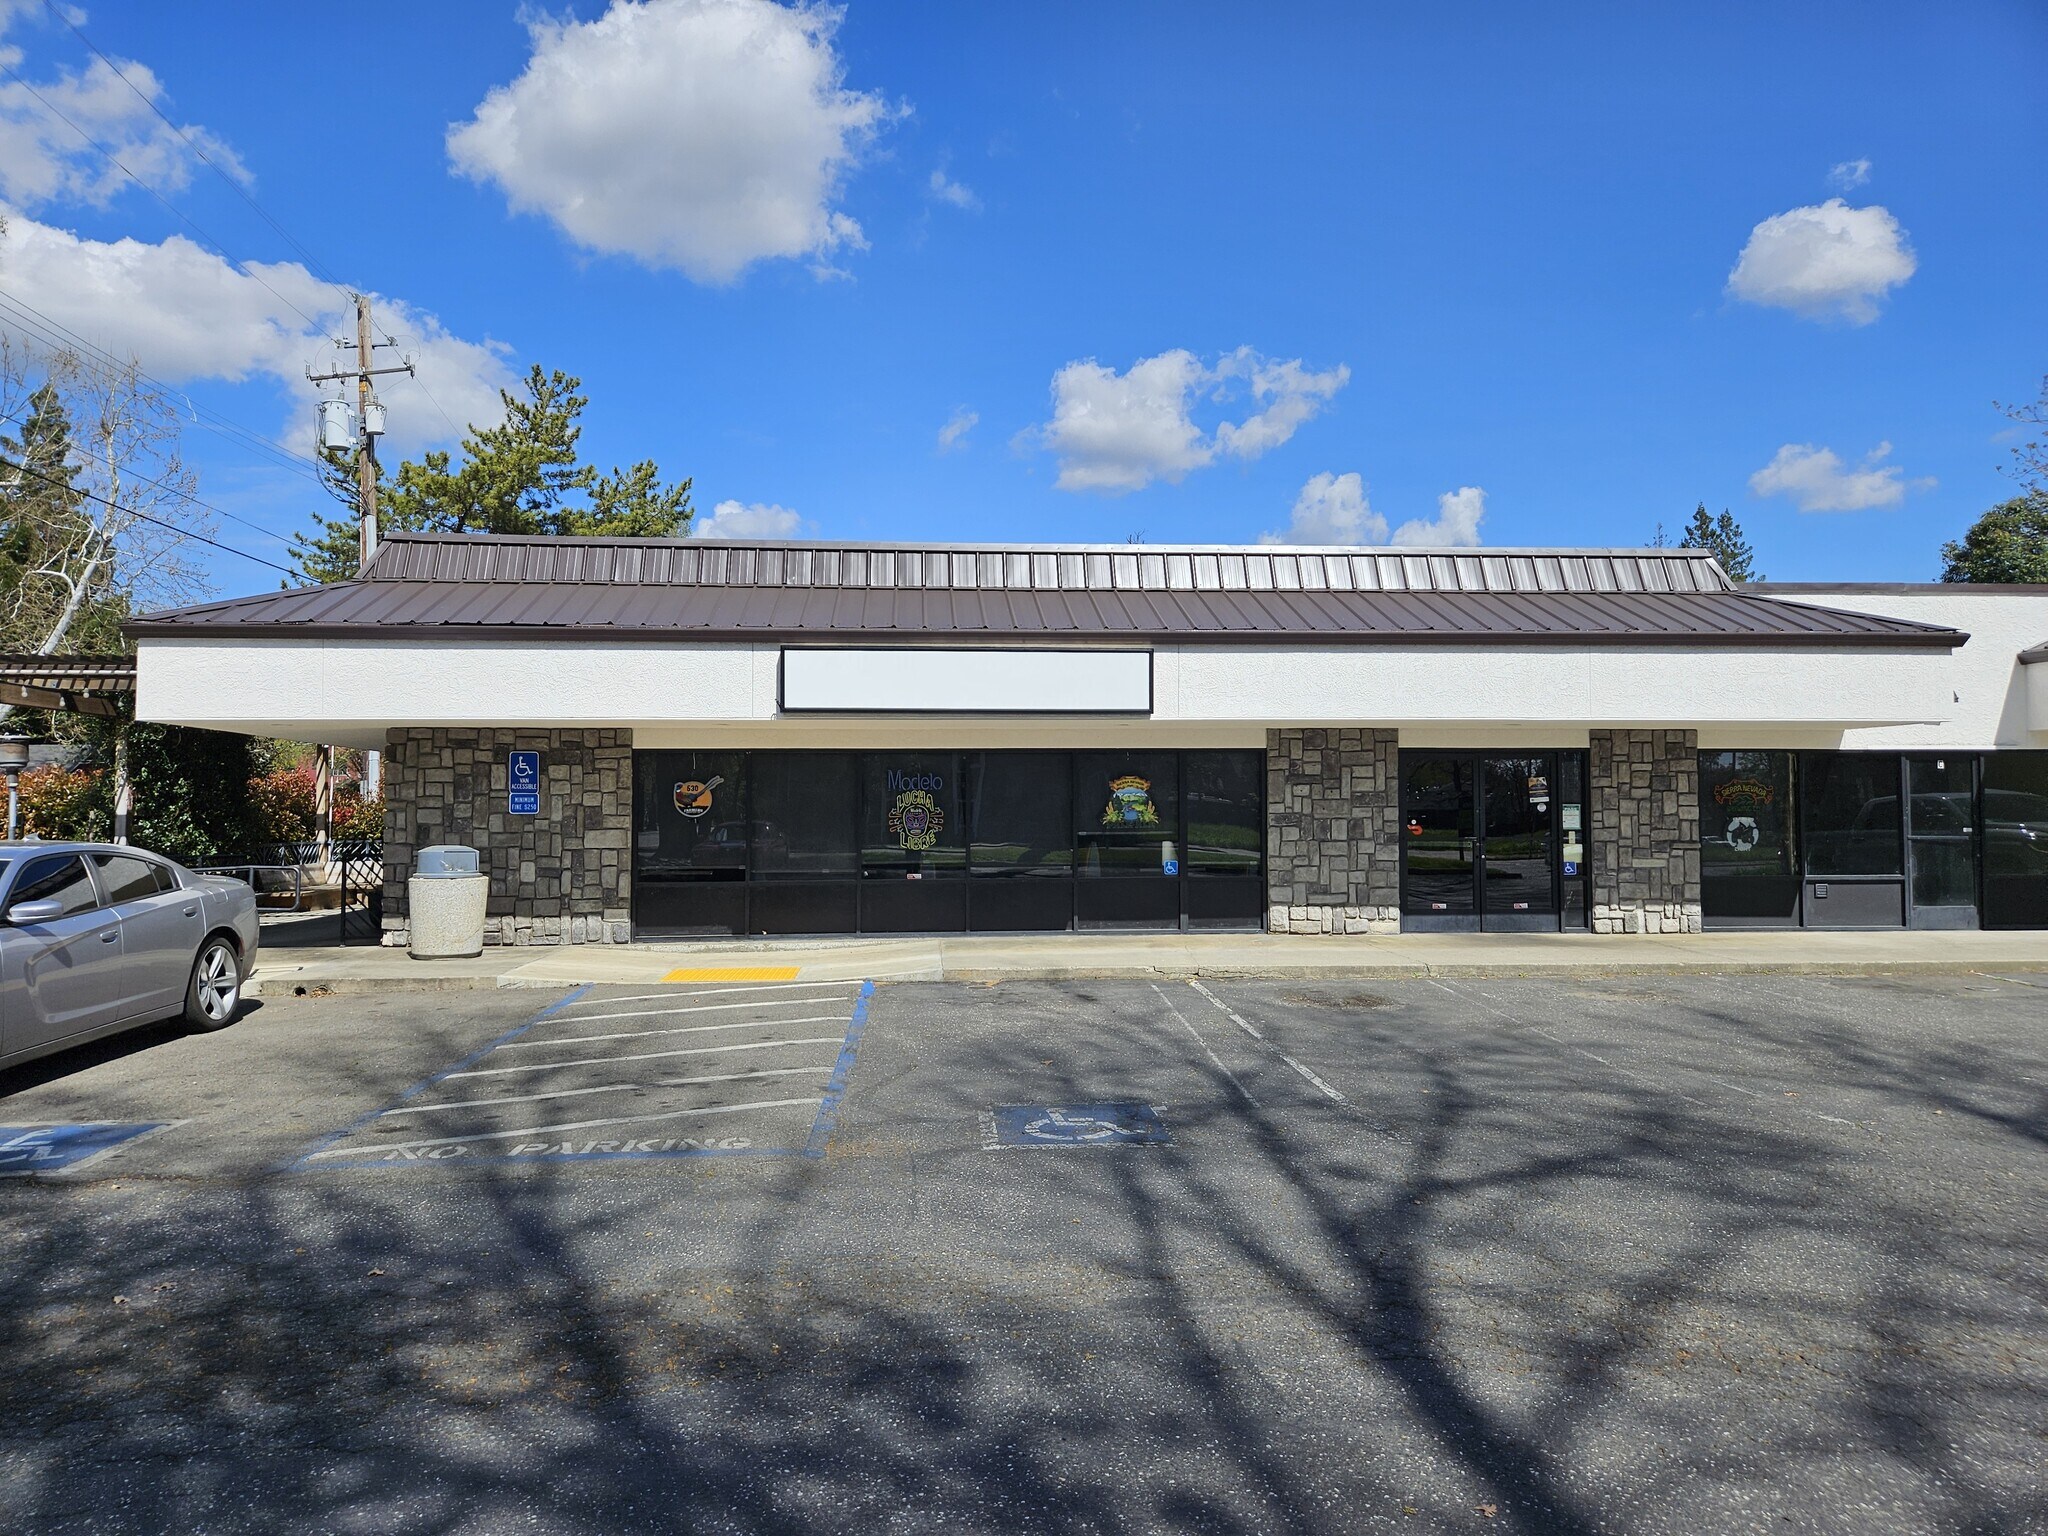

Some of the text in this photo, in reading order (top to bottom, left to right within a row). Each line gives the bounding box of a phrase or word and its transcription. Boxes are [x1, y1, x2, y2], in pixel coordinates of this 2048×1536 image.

[888, 769, 943, 791] Modelo
[1721, 784, 1767, 797] SIERRA NEVADA
[896, 790, 934, 813] LUCHA
[900, 830, 936, 850] LIBRE
[385, 1136, 753, 1160] NO PARKING
